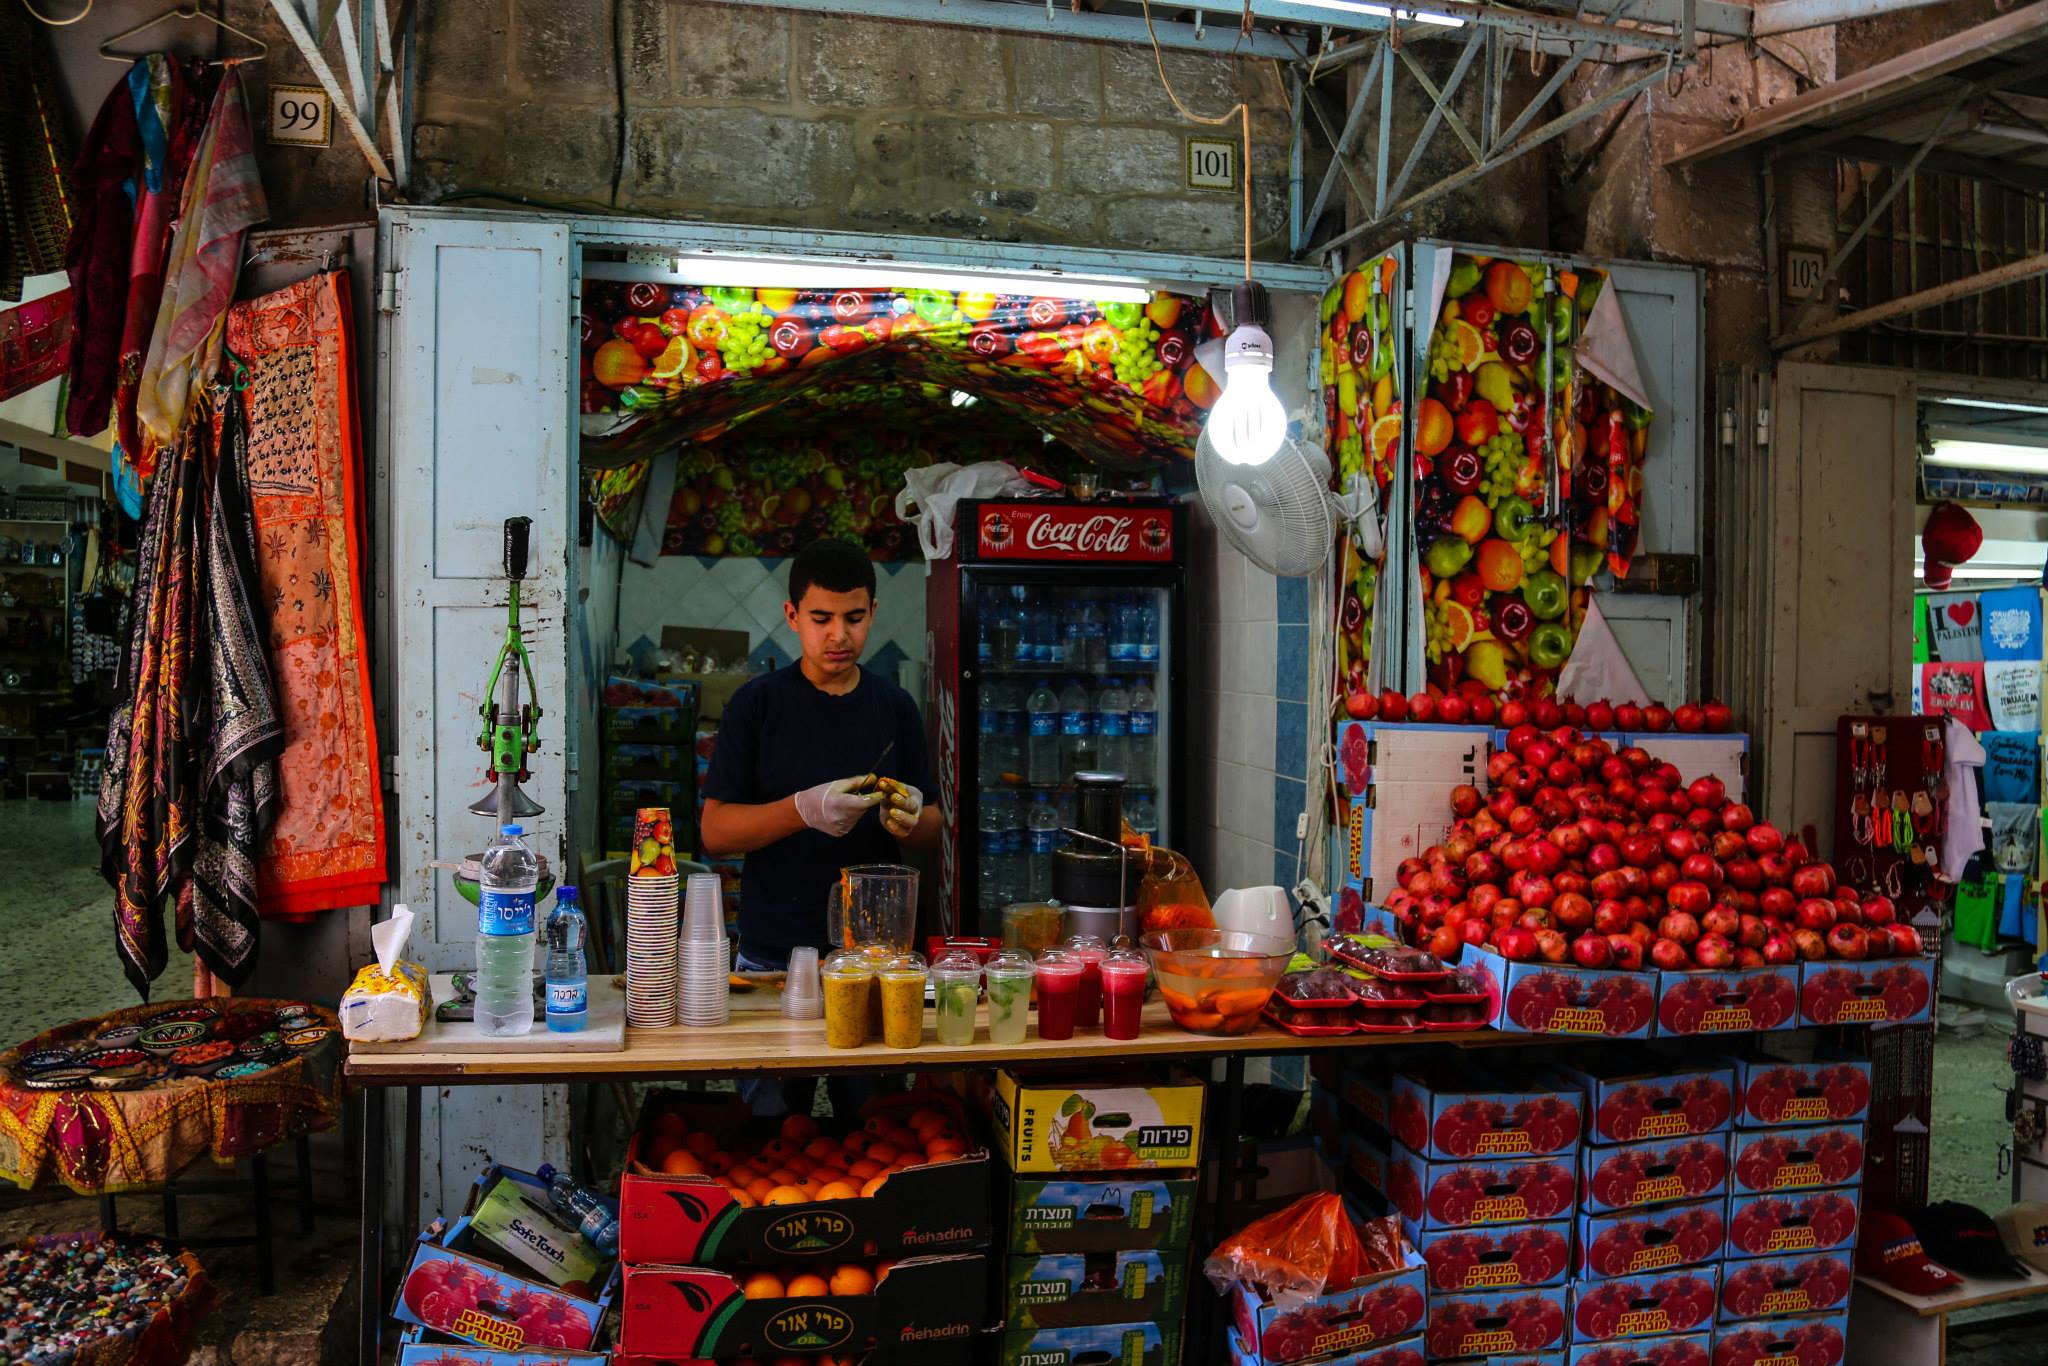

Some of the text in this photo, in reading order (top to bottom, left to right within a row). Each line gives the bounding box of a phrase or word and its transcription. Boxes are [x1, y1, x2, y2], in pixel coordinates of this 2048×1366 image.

[280, 100, 320, 131] 99
[1194, 149, 1230, 178] 101
[1792, 259, 1820, 289] 103
[1011, 510, 1032, 520] Enjoy
[1026, 512, 1134, 552] Coca-Cola
[1932, 606, 1947, 630] I
[1700, 1019, 1751, 1031] מובחרים
[1838, 1009, 1887, 1021] מובחרים
[1550, 1020, 1605, 1032] מובחרים
[1022, 1108, 1035, 1162] FRUITS
[1141, 1128, 1189, 1145] פירות
[1026, 1208, 1072, 1220] תוצרת
[776, 1216, 845, 1239] פרי אור
[902, 1226, 974, 1247] mehadrin
[1020, 1283, 1066, 1296] תוצרת
[776, 1311, 845, 1333] פרי אור
[900, 1322, 970, 1342] mehadrin
[1020, 1352, 1065, 1366] תוצרת
